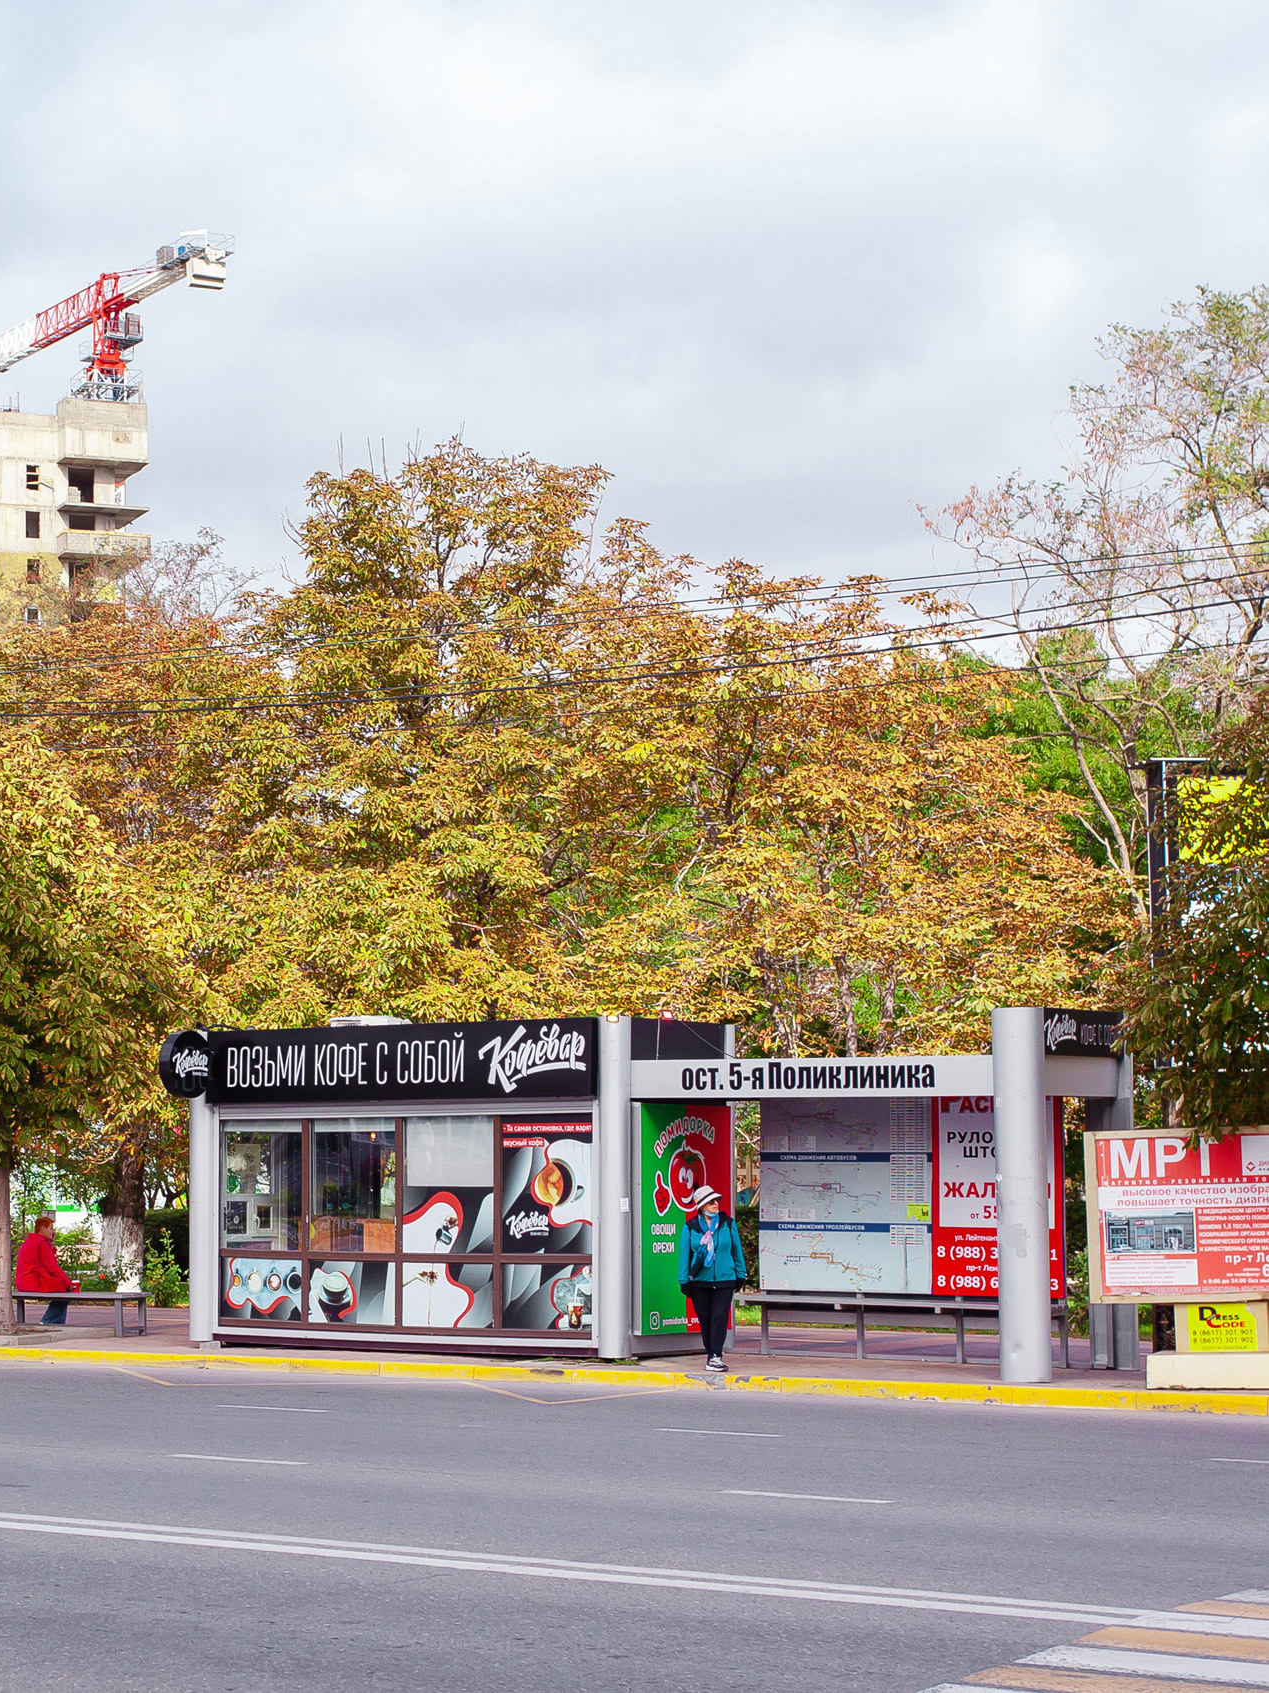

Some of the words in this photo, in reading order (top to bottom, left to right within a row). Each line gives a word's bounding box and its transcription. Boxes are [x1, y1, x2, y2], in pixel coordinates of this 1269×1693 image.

[226, 1045, 306, 1088] ВОЗЬМИ
[314, 1042, 368, 1085] КОФЕ
[376, 1041, 388, 1085] С
[397, 1032, 465, 1084] СОБОЙ
[478, 1023, 586, 1093] Кофевар
[681, 1067, 724, 1091] ост.
[729, 1062, 765, 1091] 5-я
[767, 1062, 936, 1090] Поликлиника
[564, 1125, 575, 1133] где
[503, 1139, 527, 1147] вкусный
[528, 1139, 544, 1147] кофе
[654, 1116, 715, 1158] ПОМИДОРКА
[1109, 1137, 1219, 1178] МРТ
[1171, 1177, 1247, 1185] РЕЗОНАНСНАЯ
[1122, 1187, 1171, 1197] высокое
[1175, 1186, 1227, 1195] качество
[1117, 1199, 1175, 1207] повышает
[1179, 1196, 1231, 1205] точность
[651, 1224, 676, 1236] ОВОЩИ
[795, 1223, 825, 1231] ДВИЖЕНИЯ
[825, 1223, 865, 1231] ТРОЛЛЕЙБУСОВ
[652, 1242, 675, 1253] ОРЕХИ
[936, 1245, 946, 1258] 8
[949, 1245, 986, 1261] (988)
[1225, 1254, 1253, 1265] пр-т
[936, 1274, 946, 1287] 8
[950, 1275, 986, 1290] (988)
[1206, 1314, 1246, 1328] CODE
